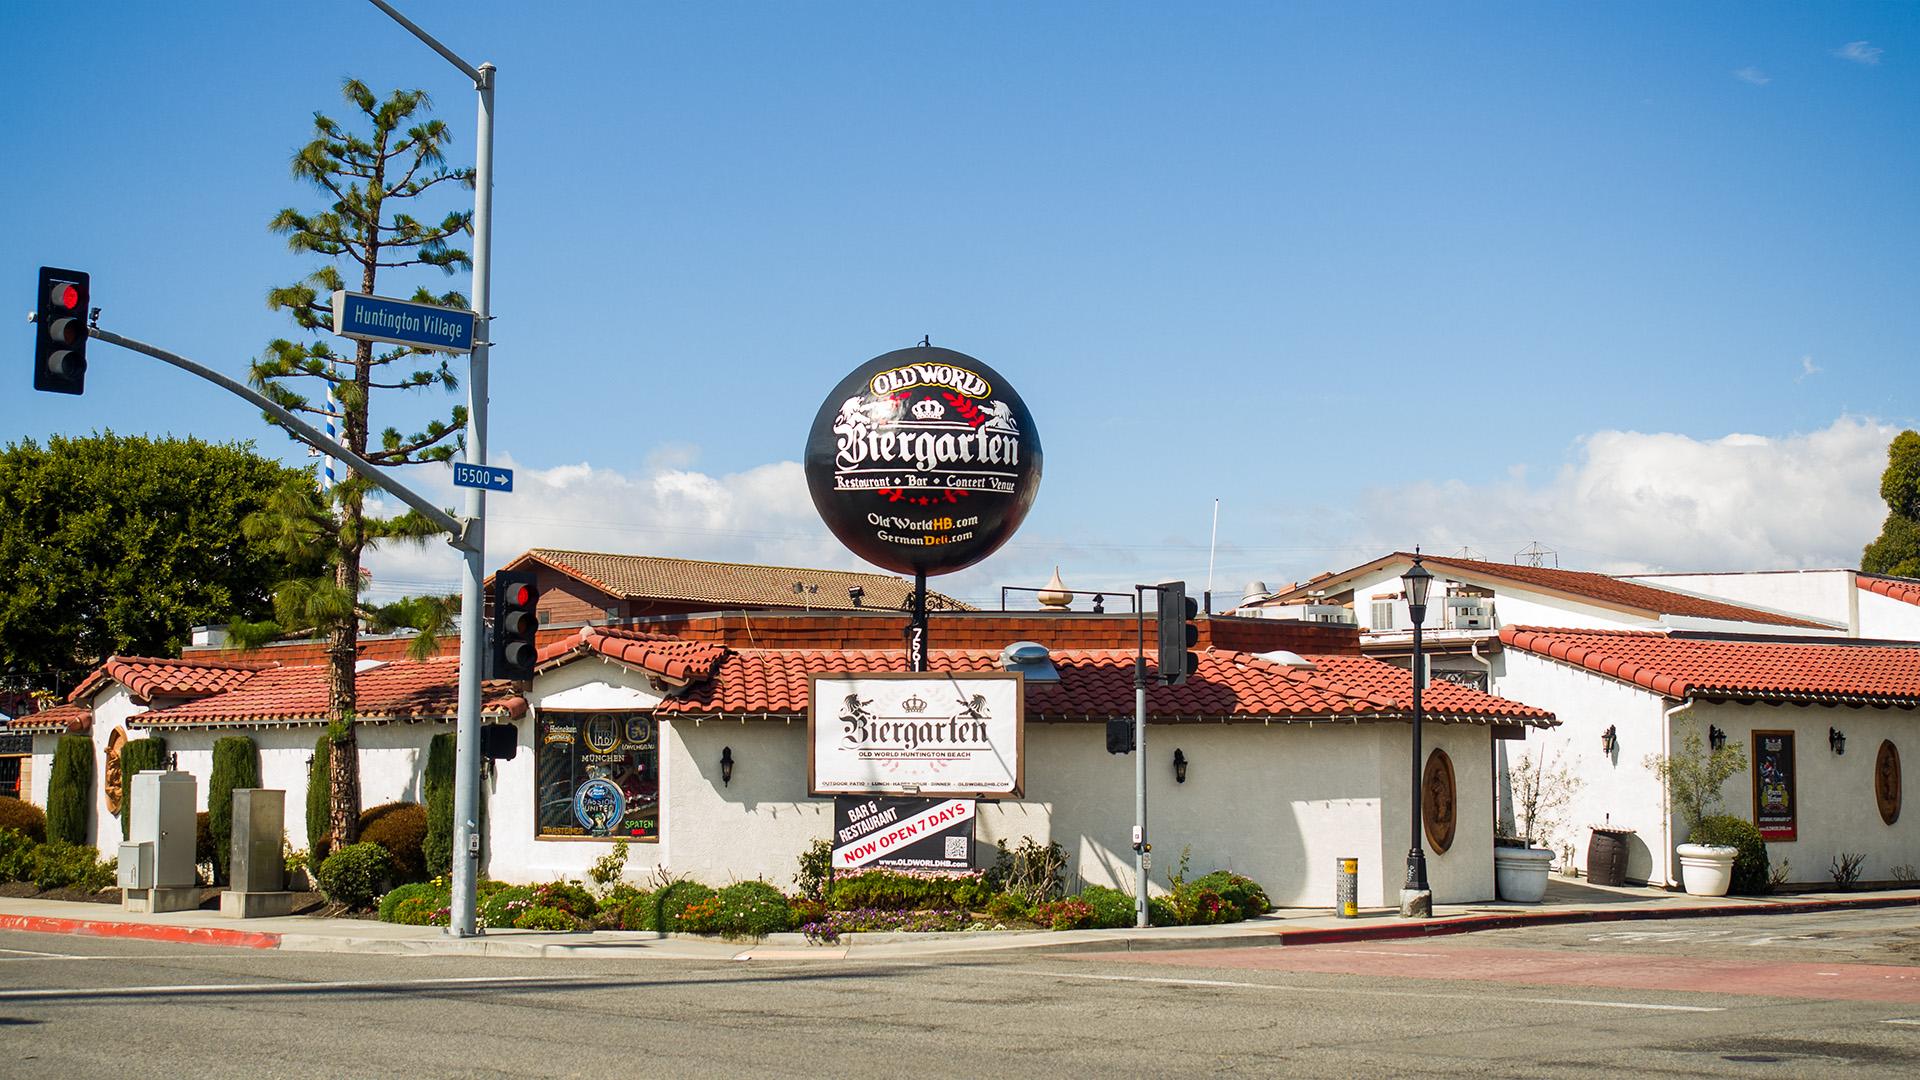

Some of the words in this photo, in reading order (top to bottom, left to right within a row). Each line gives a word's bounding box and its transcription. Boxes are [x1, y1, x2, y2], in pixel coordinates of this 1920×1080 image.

[355, 305, 420, 334] Huntington
[424, 314, 463, 343] Village
[873, 367, 917, 394] OLD
[912, 365, 987, 396] WORLD
[833, 424, 1019, 471] Biergarten
[457, 467, 490, 485] 15500
[835, 475, 890, 488] Restaurant
[905, 474, 928, 487] Bar
[946, 475, 985, 488] Concert
[988, 477, 1015, 491] Venue
[877, 530, 973, 545] GermanDeli.com
[838, 713, 989, 750] Biergarten
[624, 820, 654, 829] SPATEN
[838, 807, 898, 843] RESTAURANT
[847, 805, 870, 823] BAR
[867, 801, 878, 813] &
[843, 841, 877, 864] NOW
[879, 824, 918, 848] OPEN
[917, 819, 927, 831] 7
[928, 803, 966, 827] DAYS
[878, 859, 968, 868] www.OLDWORLDHB.com
